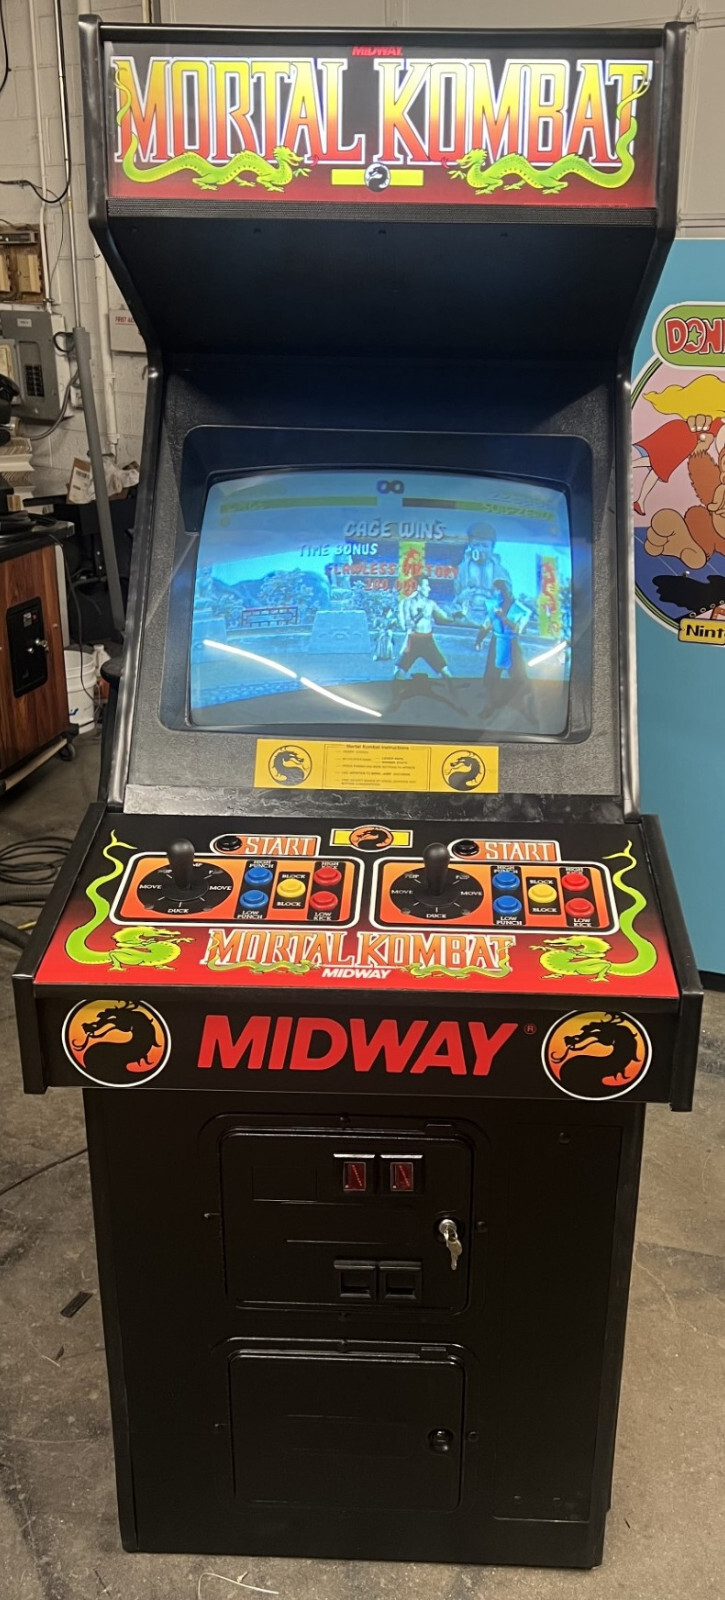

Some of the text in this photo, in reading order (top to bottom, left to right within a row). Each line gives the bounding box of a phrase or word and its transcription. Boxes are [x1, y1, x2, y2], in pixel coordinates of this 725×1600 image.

[352, 46, 403, 56] MIDWAY
[110, 56, 654, 167] MORTAL KOMBAT
[665, 317, 725, 354] DON
[344, 520, 443, 539] CAGE WINS
[300, 543, 379, 557] TIME BONUS
[325, 562, 396, 576] FLAWLESS
[686, 624, 725, 639] Nint
[245, 837, 310, 856] START
[486, 841, 553, 861] START
[200, 928, 516, 972] MORTAL KOMBAT
[321, 968, 391, 979] MIDWAY
[196, 1013, 518, 1077] MIDWAY
